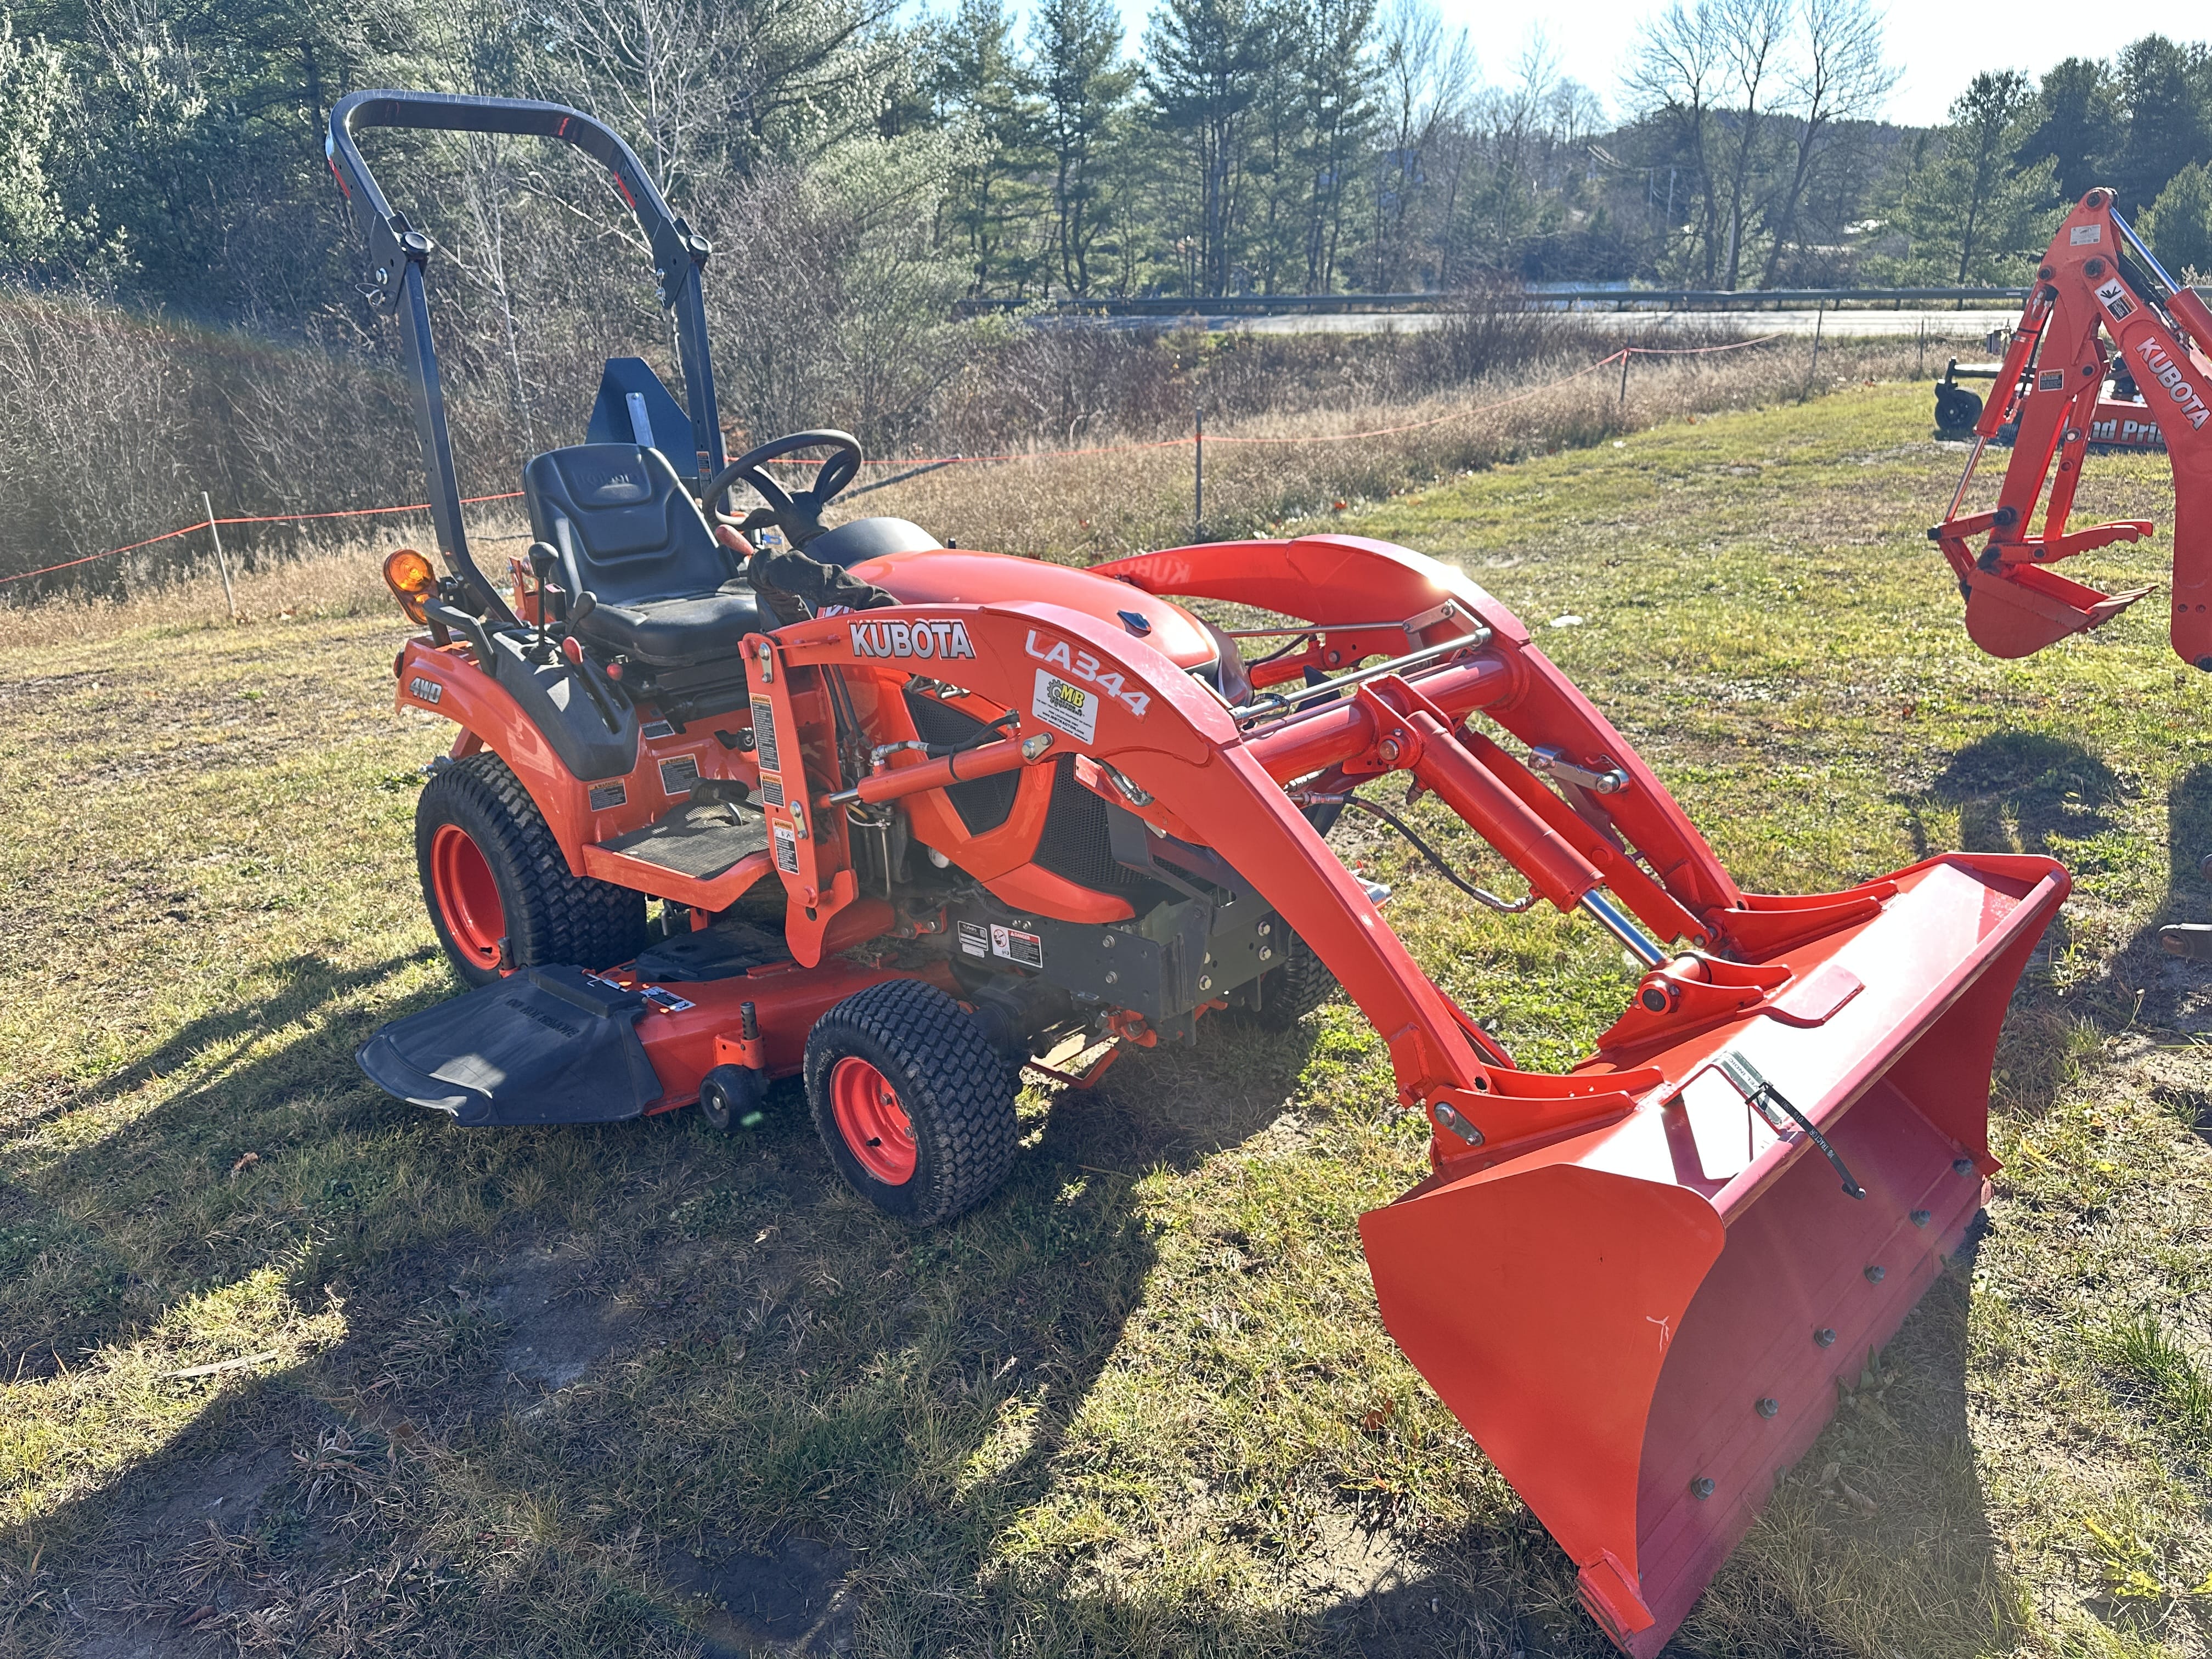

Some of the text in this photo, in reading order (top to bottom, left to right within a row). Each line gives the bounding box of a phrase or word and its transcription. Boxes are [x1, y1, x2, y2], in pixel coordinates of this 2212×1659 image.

[2135, 336, 2211, 431] KUBOTA
[849, 622, 975, 659] KUBOTA
[1025, 630, 1151, 716] LA344
[409, 676, 443, 705] 4WD
[1060, 684, 1085, 708] MB
[1809, 1128, 1829, 1152] TRACTOR
